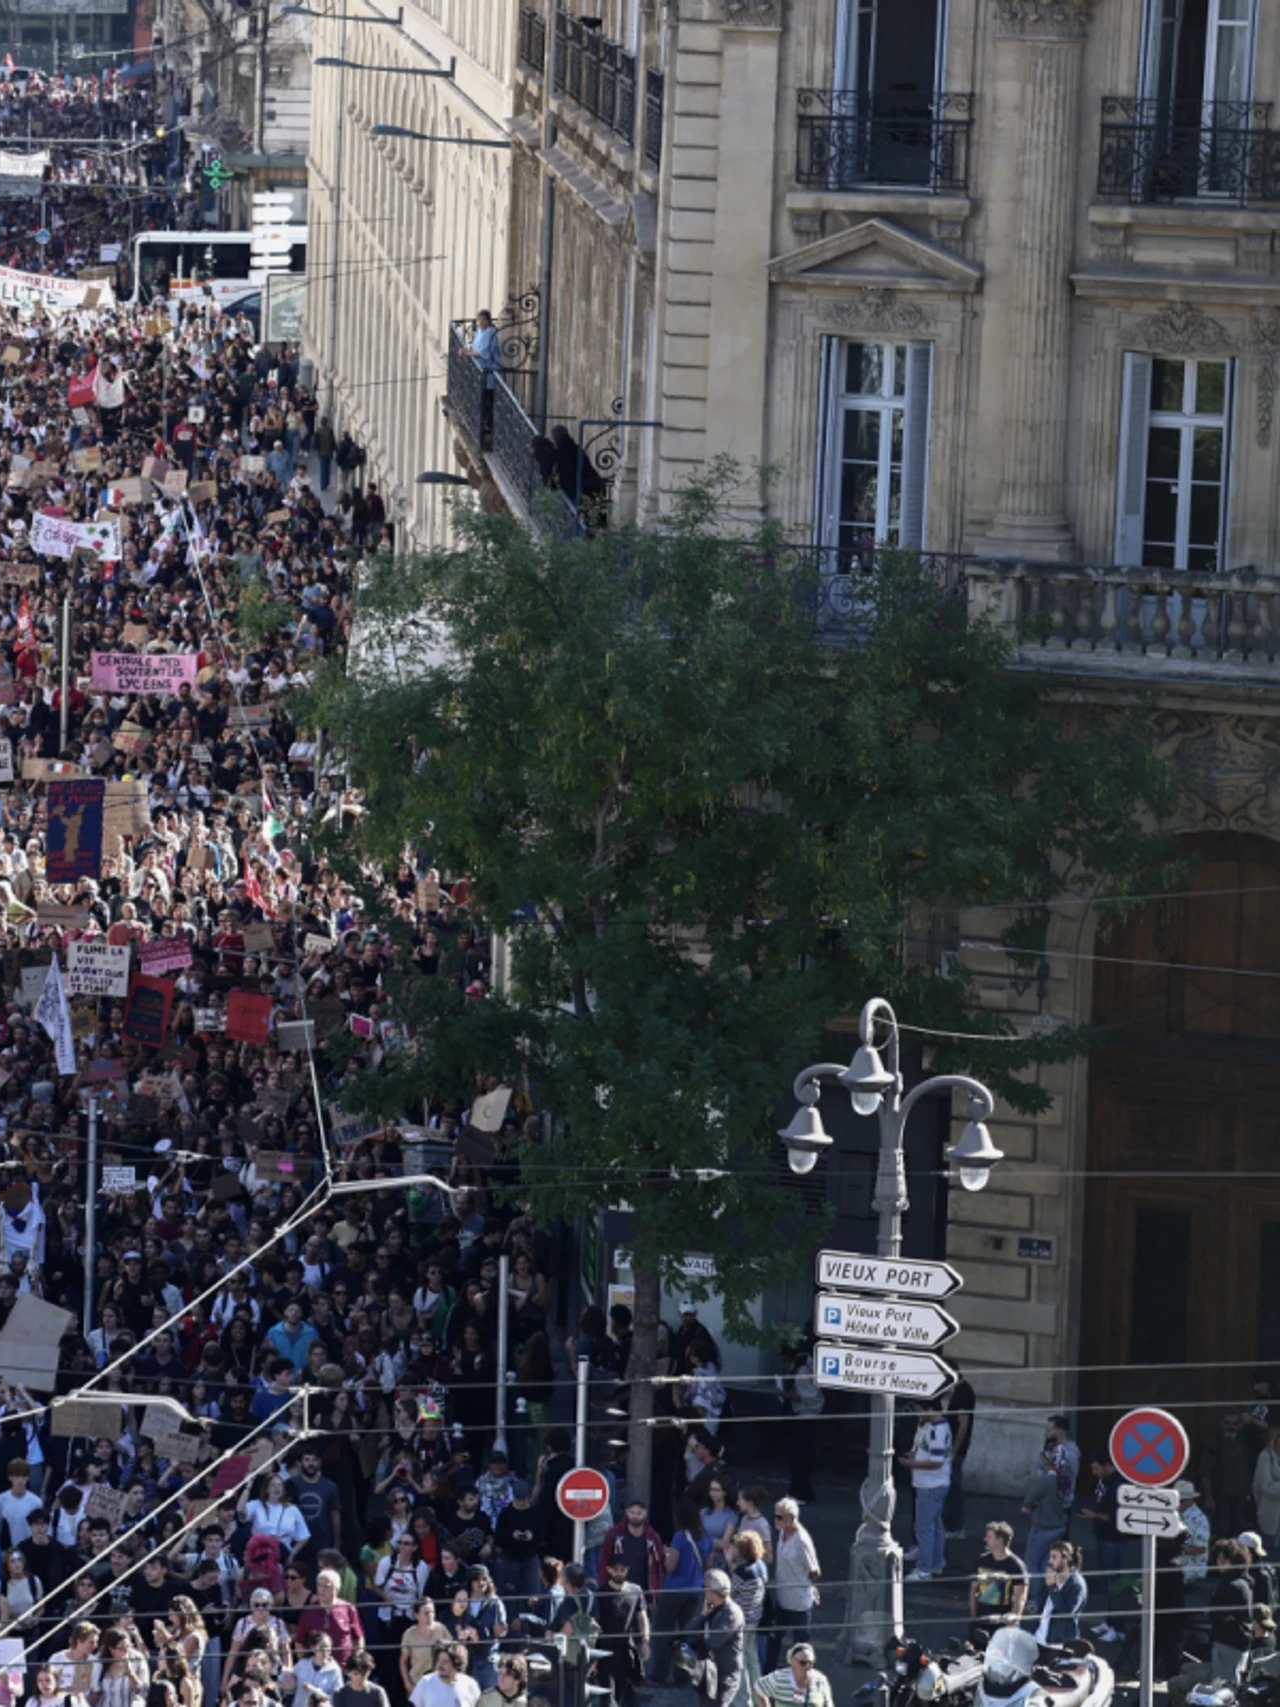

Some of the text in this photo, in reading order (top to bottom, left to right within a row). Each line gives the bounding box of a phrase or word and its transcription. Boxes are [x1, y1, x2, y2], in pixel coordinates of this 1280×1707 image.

[826, 1261, 933, 1287] VIEUX PORT
[847, 1303, 882, 1319] Vieux
[885, 1307, 912, 1321] Port
[845, 1320, 929, 1341] Hôtel de Ville
[844, 1353, 897, 1371] Bourse
[843, 1370, 877, 1385] Musée
